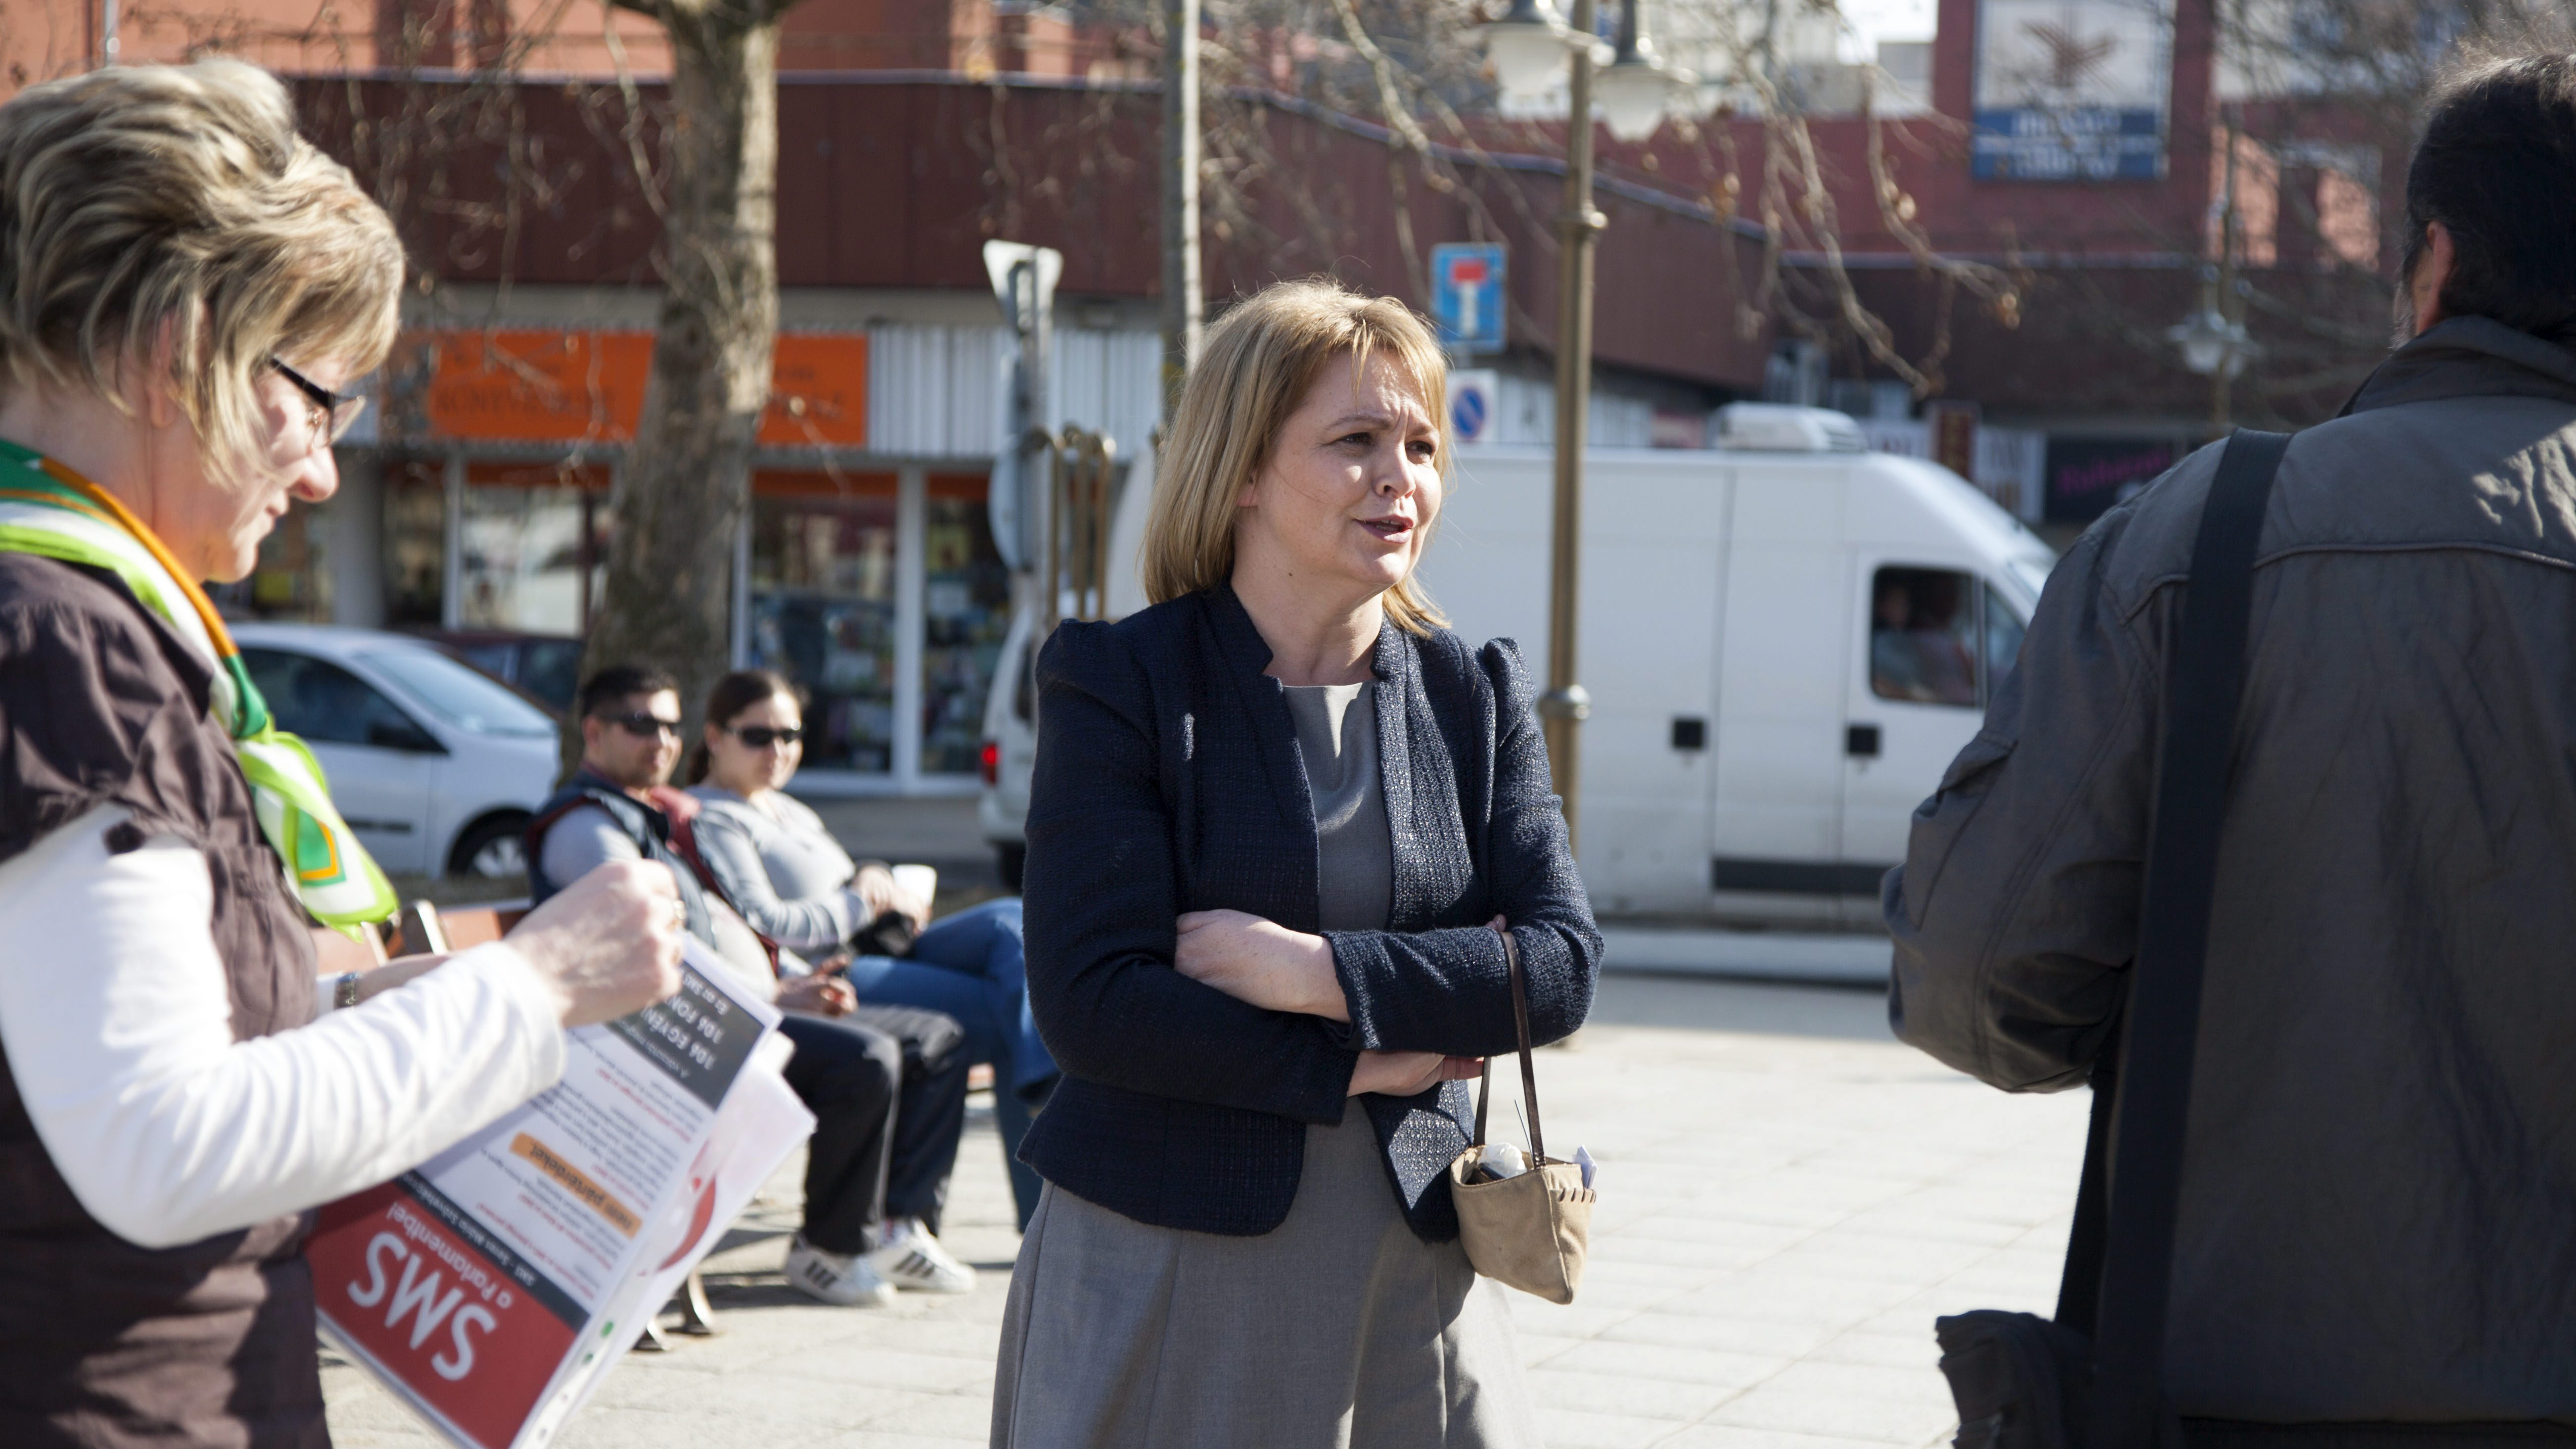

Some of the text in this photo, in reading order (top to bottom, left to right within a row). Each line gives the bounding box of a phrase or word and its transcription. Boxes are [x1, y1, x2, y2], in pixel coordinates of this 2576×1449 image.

[697, 1016, 723, 1043] 106
[689, 1042, 715, 1070] 106
[387, 1204, 498, 1299] Parlamentbe!
[514, 1265, 536, 1286] SMS
[348, 1230, 496, 1381] SMS
[496, 1289, 513, 1309] a
